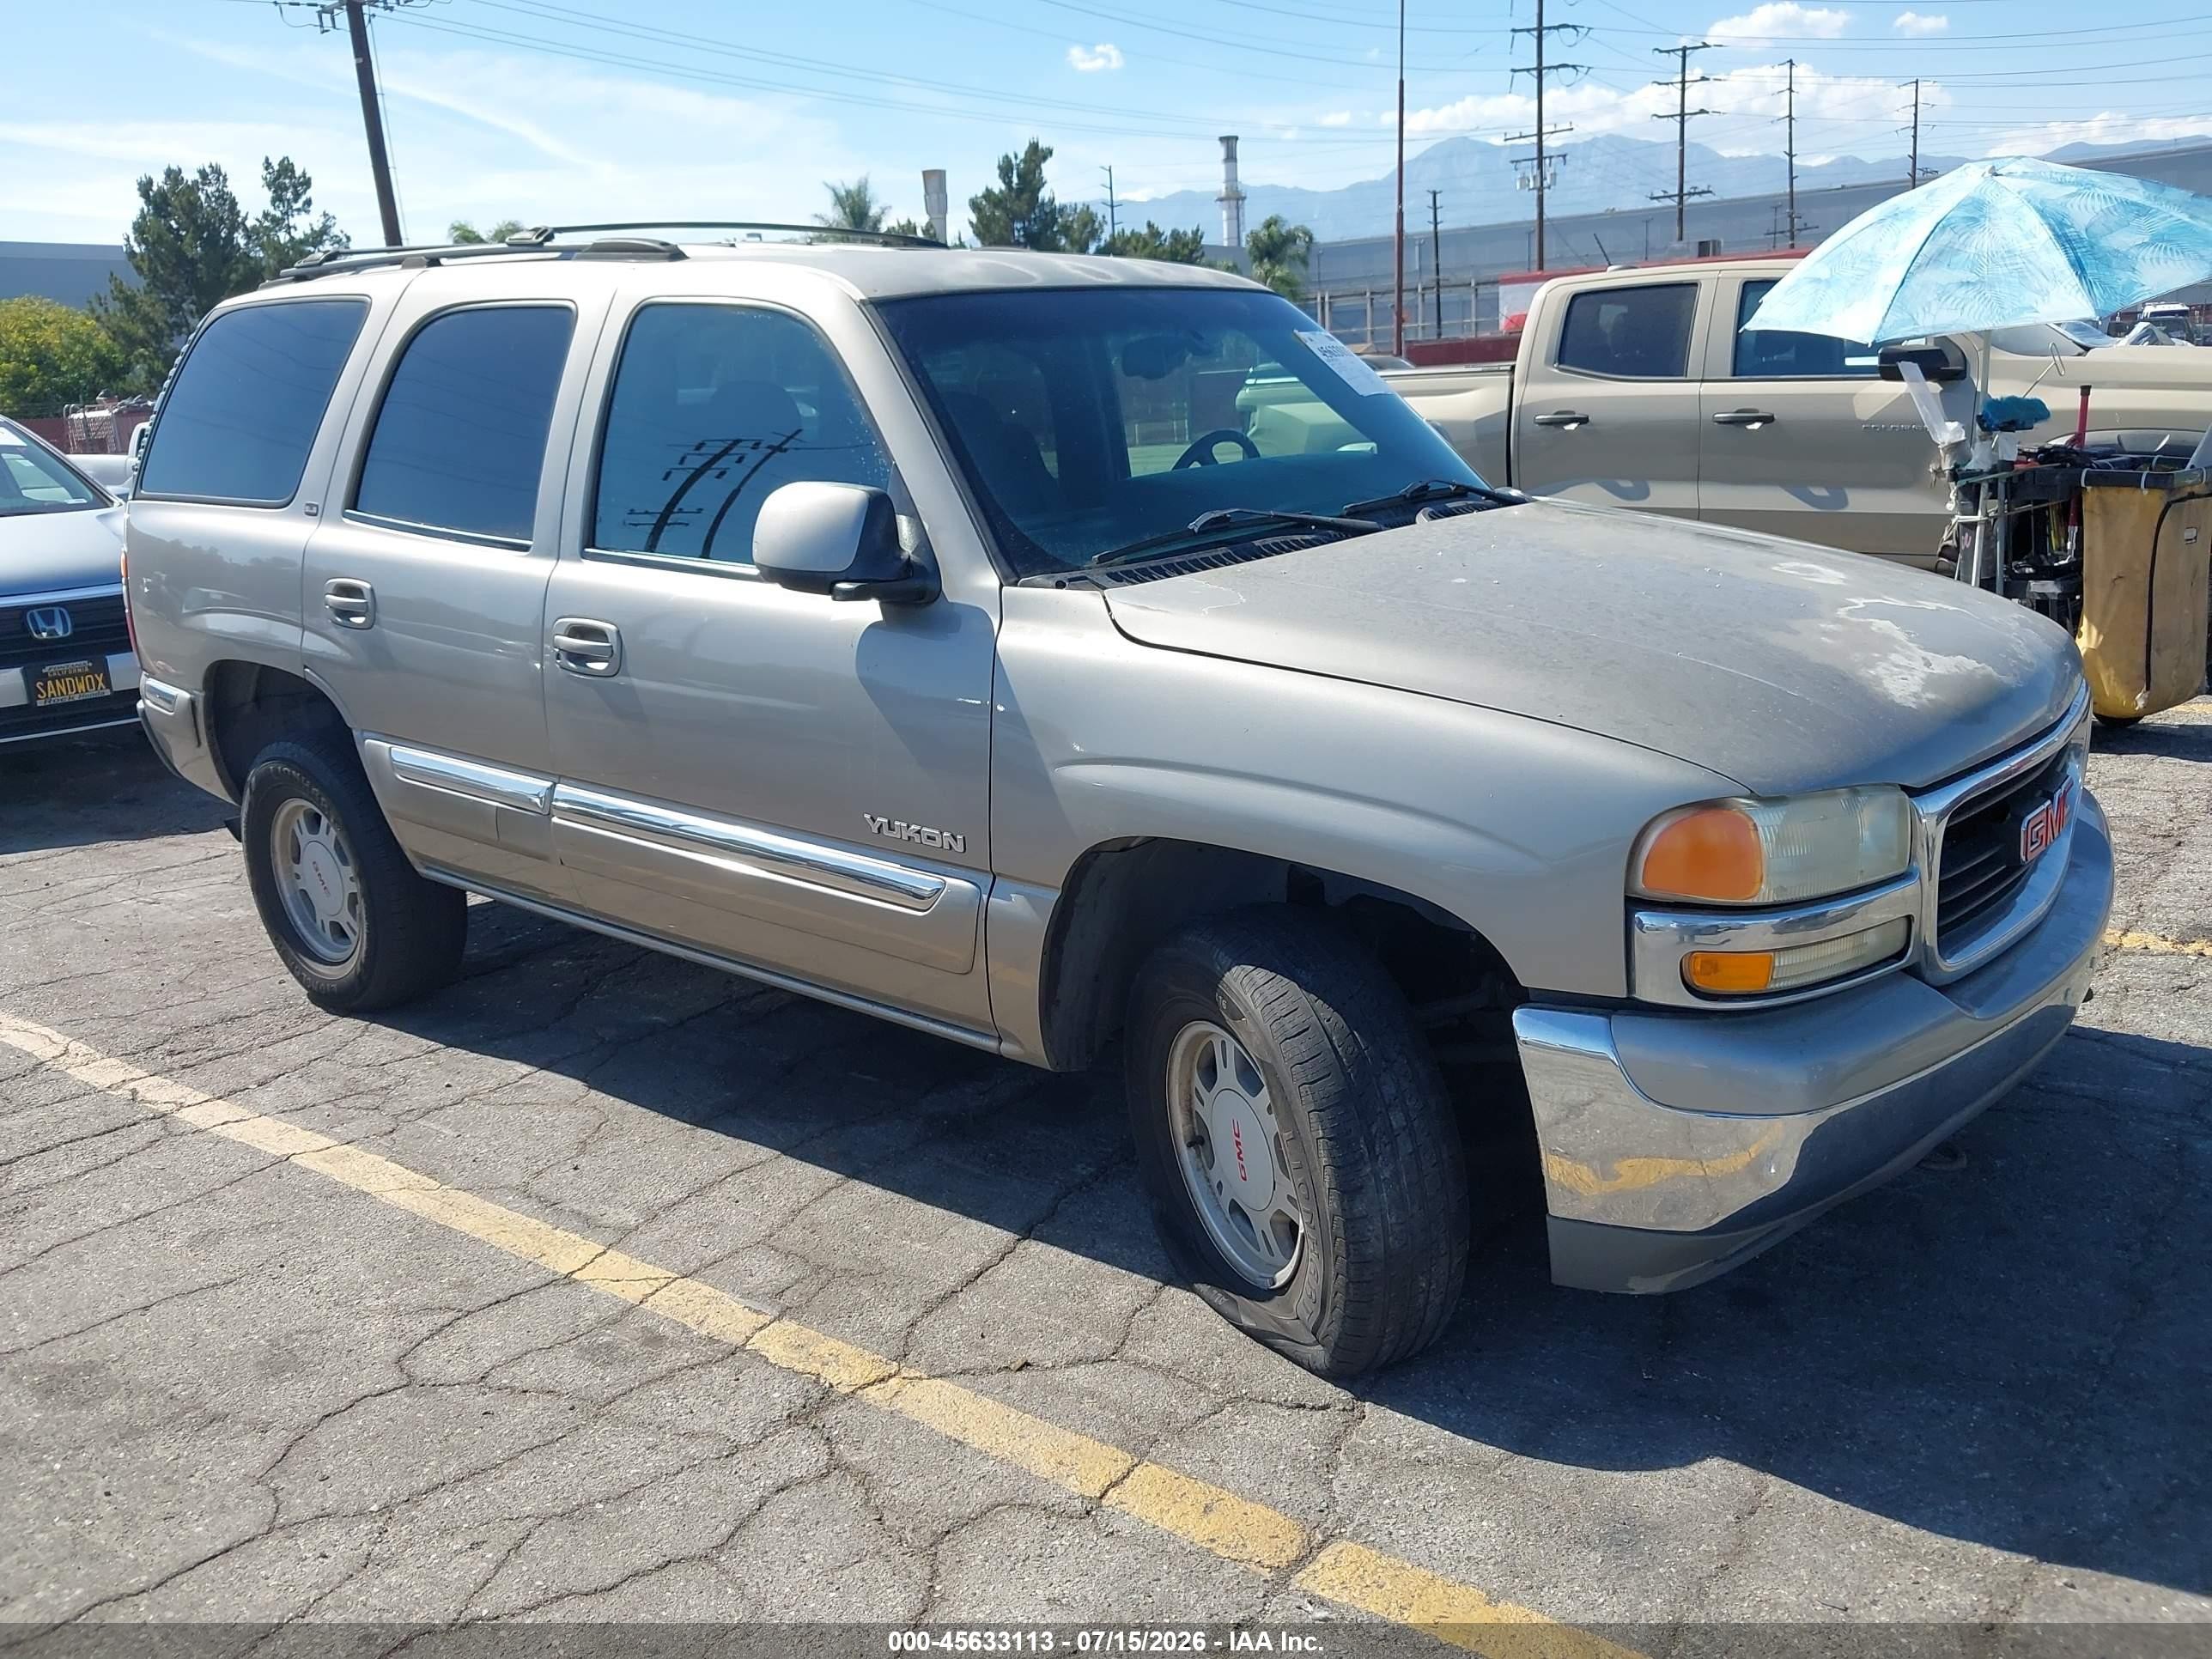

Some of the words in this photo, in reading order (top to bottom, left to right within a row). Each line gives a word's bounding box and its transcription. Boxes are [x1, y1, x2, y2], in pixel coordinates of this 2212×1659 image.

[36, 673, 106, 699] SANDWOX
[864, 813, 967, 853] YUKON
[2021, 775, 2074, 864] GMC
[1231, 1118, 1247, 1182] GMC
